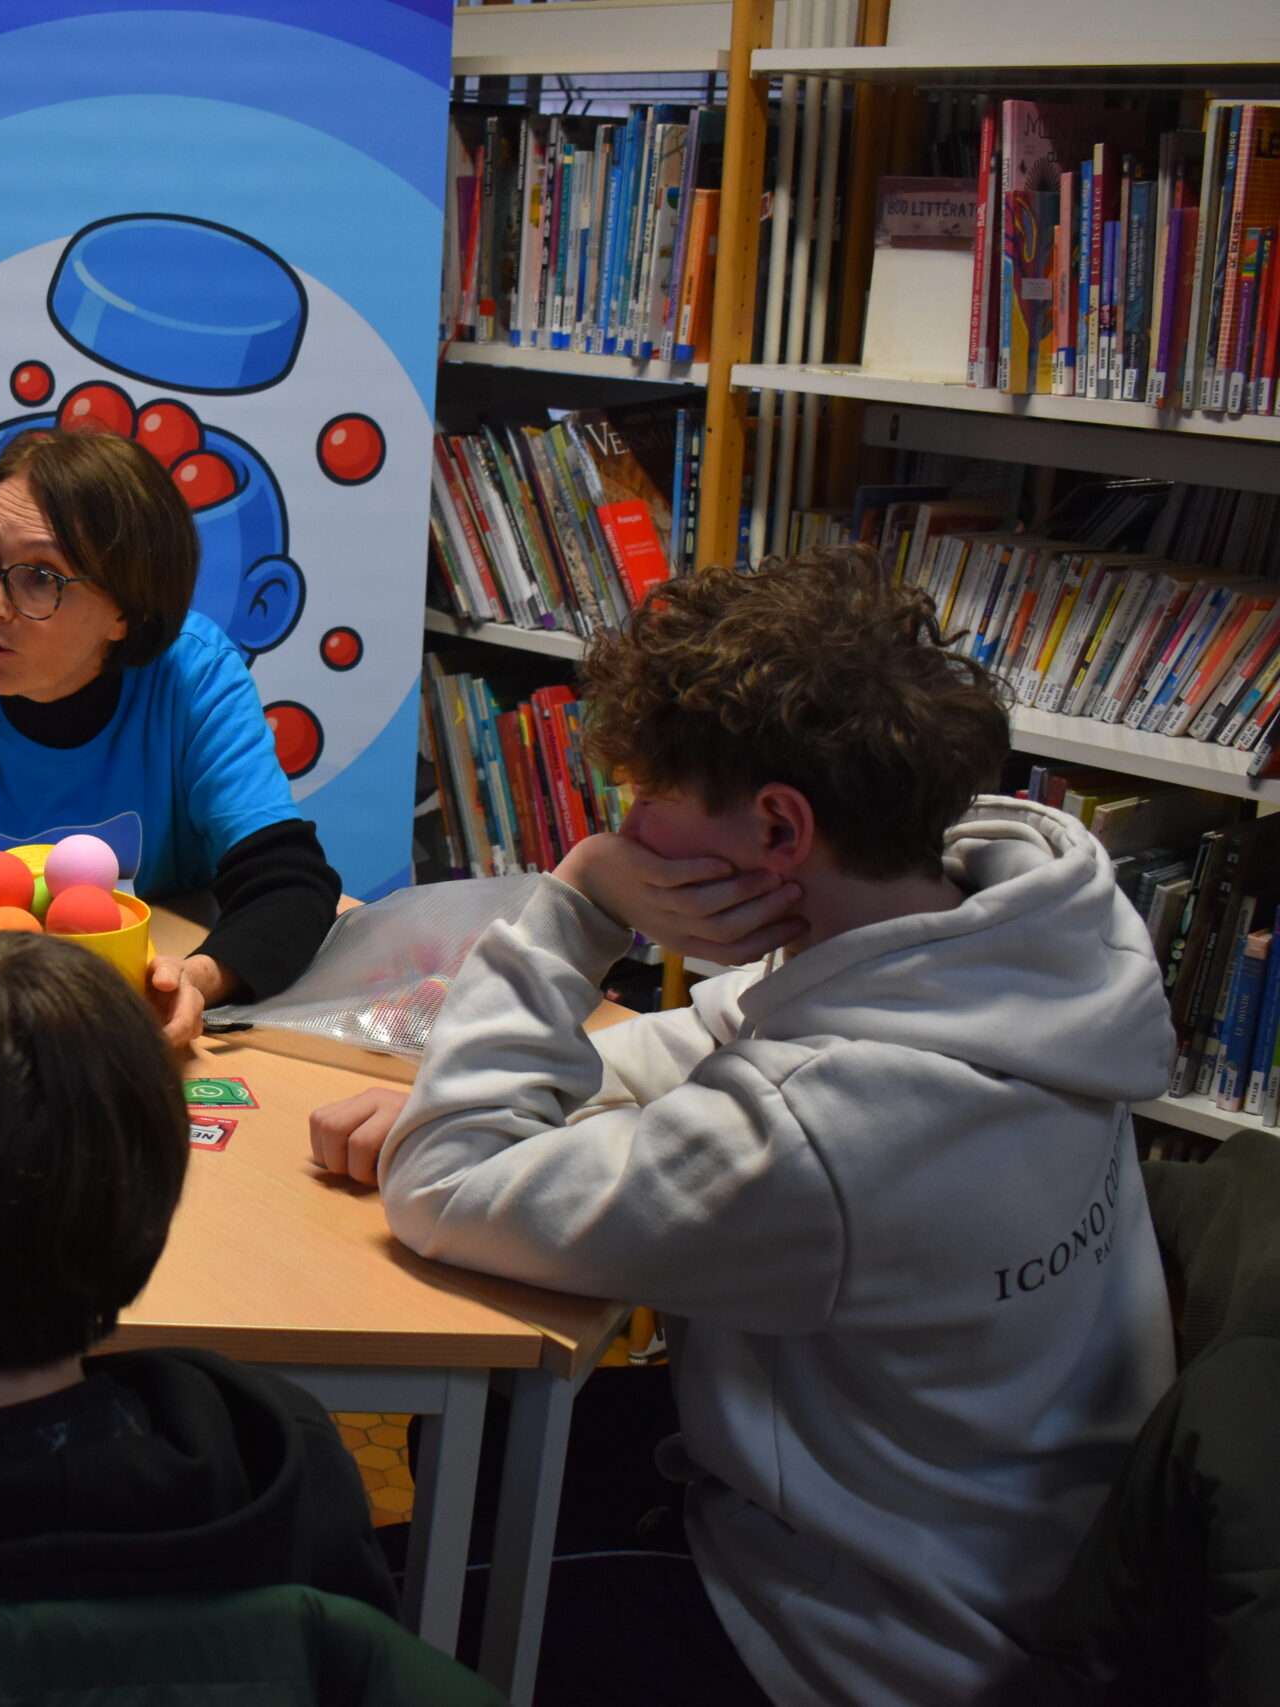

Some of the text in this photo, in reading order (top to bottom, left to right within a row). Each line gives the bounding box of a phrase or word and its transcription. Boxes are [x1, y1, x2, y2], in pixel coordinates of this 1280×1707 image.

[911, 198, 977, 217] LITTÉRAT
[191, 1131, 215, 1141] NE
[994, 1201, 1106, 1302] ICONO
